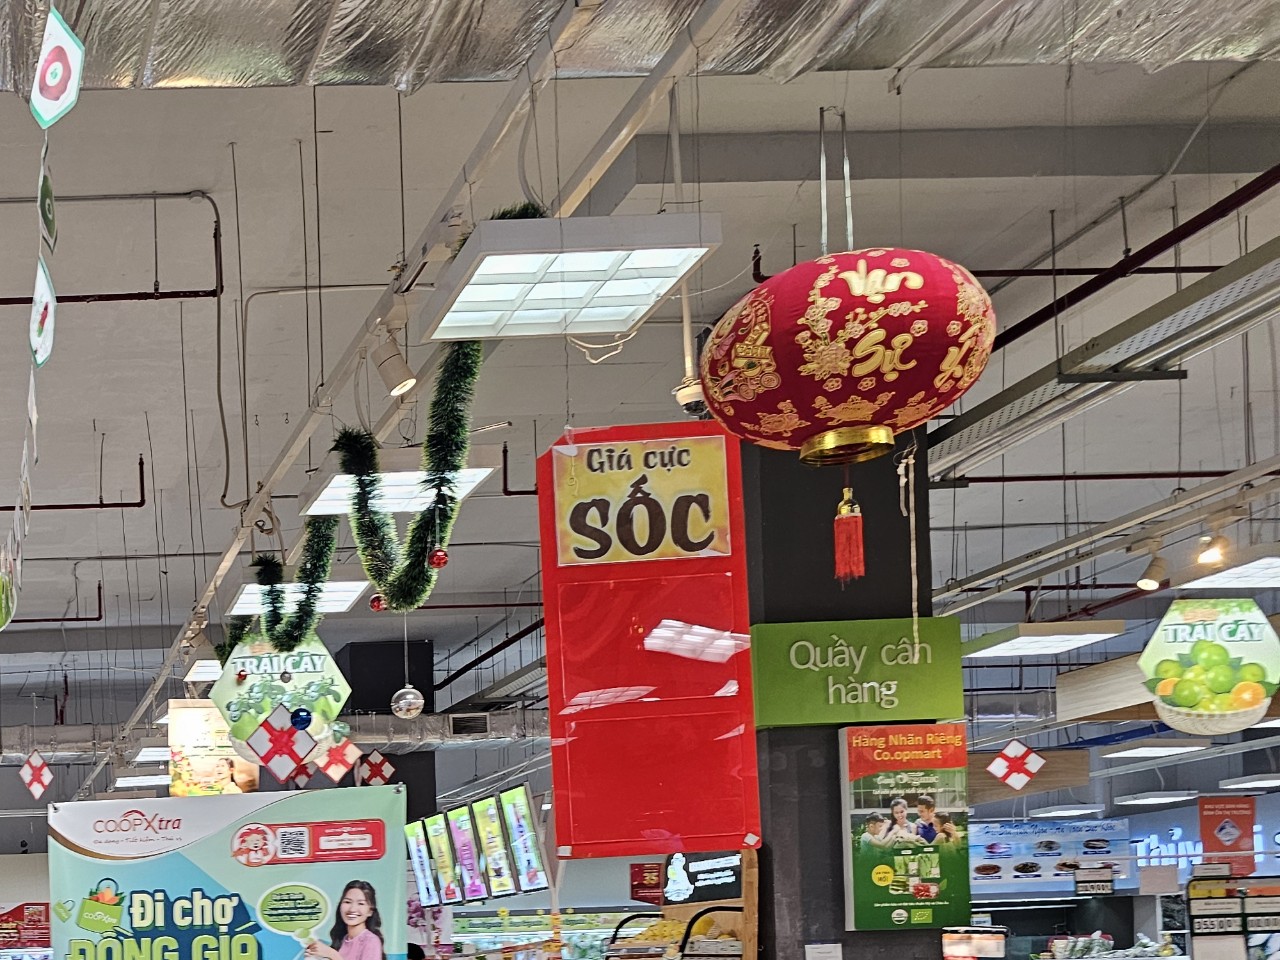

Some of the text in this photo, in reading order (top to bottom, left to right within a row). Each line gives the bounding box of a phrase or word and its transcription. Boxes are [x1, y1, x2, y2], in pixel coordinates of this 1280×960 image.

[587, 445, 691, 474] Giá cực
[569, 474, 715, 560] SỐC
[790, 634, 932, 674] Quầy cân
[828, 677, 898, 708] hàng
[852, 733, 962, 749] Hàng Nhãn Riêng
[873, 749, 942, 762] Co.opmart
[1129, 827, 1204, 869] Thủy
[130, 892, 164, 929] Đi
[172, 891, 239, 932] chợ
